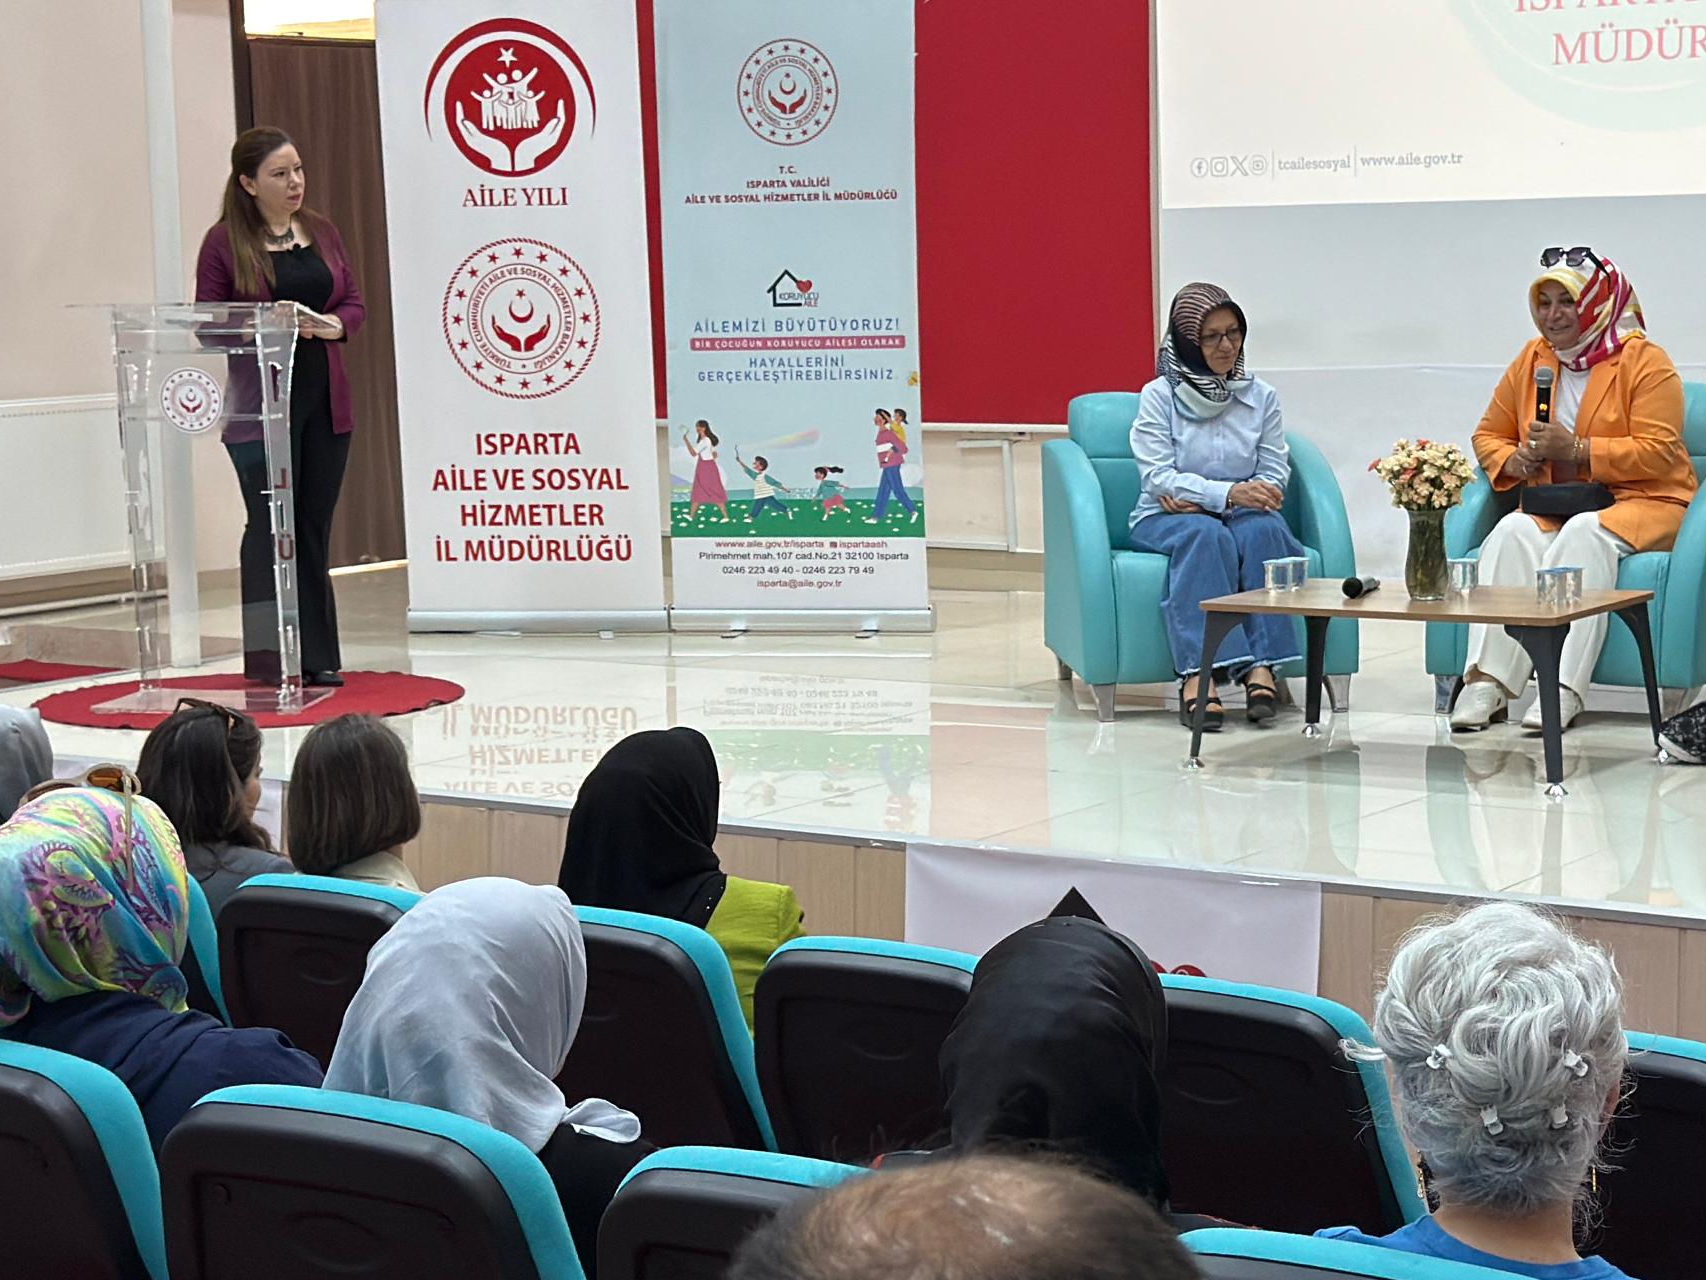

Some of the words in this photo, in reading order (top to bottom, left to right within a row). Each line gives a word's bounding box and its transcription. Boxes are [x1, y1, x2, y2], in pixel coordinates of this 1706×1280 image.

[1278, 155, 1350, 172] tcailesosyal
[1360, 153, 1463, 167] www.aile.gov.tr
[779, 166, 797, 174] T.C.
[747, 180, 787, 189] ISPARTA
[462, 184, 517, 207] AİLE
[521, 187, 568, 206] YILI
[685, 193, 706, 204] AİLE
[709, 195, 721, 204] VE
[725, 194, 761, 203] SOSYAL
[764, 191, 820, 202] HİZMETLER
[822, 191, 831, 201] İL
[834, 189, 898, 200] MÜDÜRLÜĞÜ
[694, 318, 766, 333] AİLEMİZİ
[775, 317, 899, 332] BÜYÜTÜYORUZ!
[695, 340, 710, 348] BİR
[715, 338, 762, 349] ÇOCUĞUN
[767, 338, 821, 348] KORUYUCU
[825, 338, 856, 346] AİLESİ
[861, 338, 901, 346] OLARAK
[749, 354, 844, 367] HAYALLERİNİ
[476, 433, 580, 455] ISPARTA
[433, 464, 487, 491] AİLE
[492, 469, 525, 490] VE
[532, 468, 629, 490] SOSYAL
[461, 500, 604, 526] HİZMETLER
[436, 535, 457, 562] İL
[465, 535, 632, 561] MÜDÜRLÜĞÜ
[722, 566, 745, 574] 0246
[748, 566, 765, 574] 223
[768, 566, 779, 574] 49
[782, 566, 793, 574] 40
[802, 566, 825, 574] 0246
[829, 566, 845, 574] 223
[847, 566, 860, 574] 79
[862, 566, 874, 574] 49
